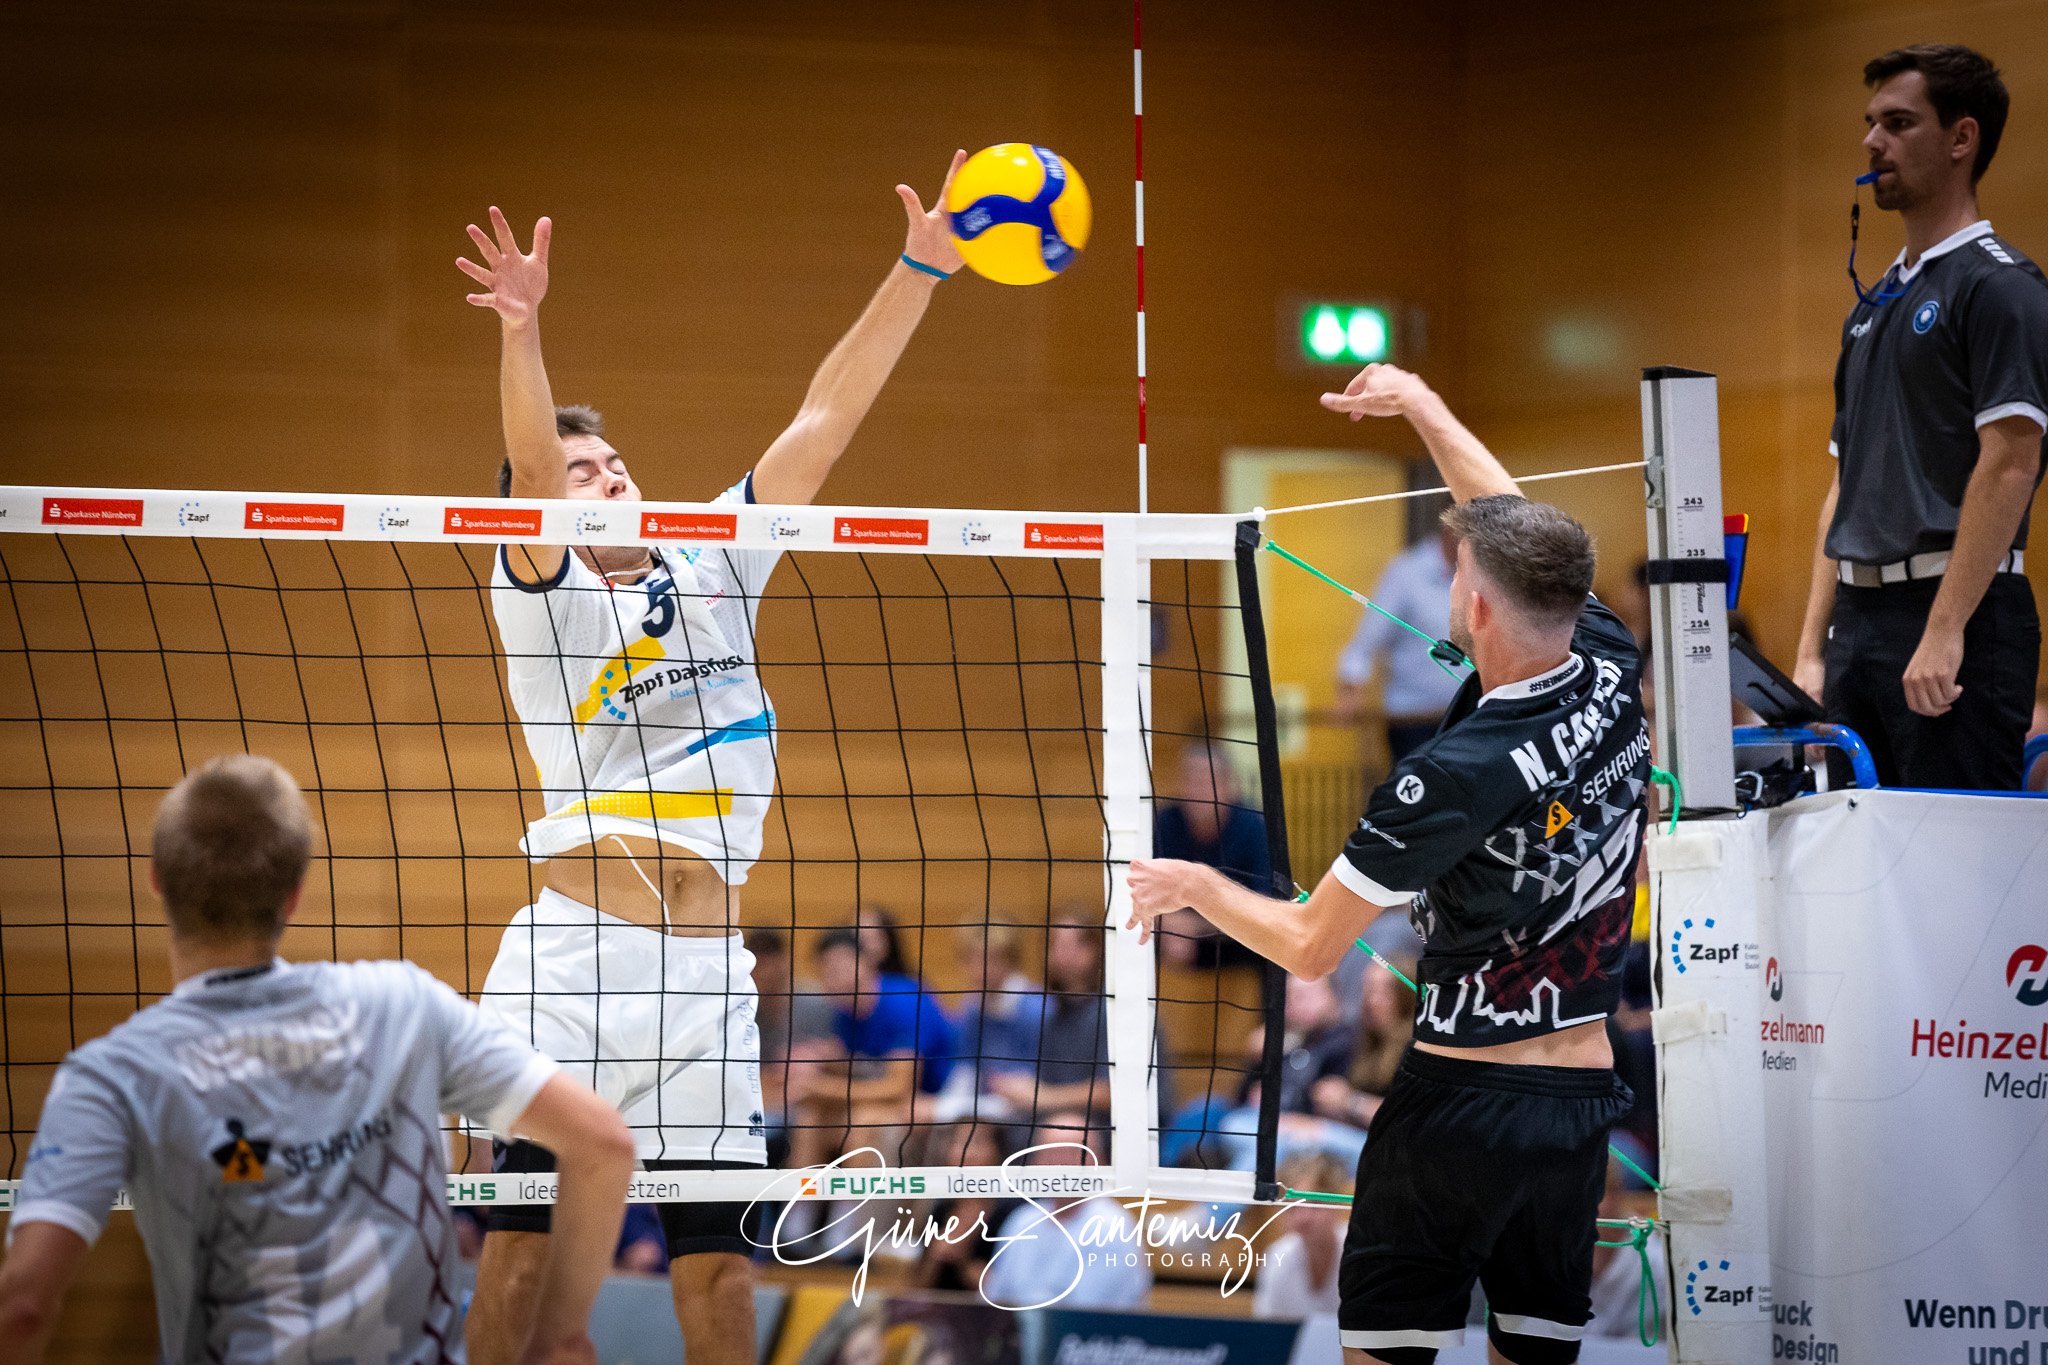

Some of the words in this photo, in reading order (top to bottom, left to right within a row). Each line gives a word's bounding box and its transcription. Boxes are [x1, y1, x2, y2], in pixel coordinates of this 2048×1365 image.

[1684, 497, 1704, 506] 243
[63, 510, 101, 520] Sparkasse
[101, 511, 136, 521] Nürnberg
[187, 514, 210, 523] Zapf
[265, 514, 302, 524] Sparkasse
[303, 516, 337, 526] Nürnberg
[387, 519, 409, 528] Zapf
[464, 519, 500, 529] Sparkasse
[501, 521, 535, 530] Nürnberg
[585, 523, 606, 532] Zapf
[660, 524, 696, 533] Sparkasse
[697, 526, 730, 535] Nürnberg
[779, 528, 800, 537] Zapf
[853, 529, 889, 538] Sparkasse
[890, 530, 922, 540] Nürnberg
[970, 533, 991, 542] Zapf
[1044, 535, 1078, 543] Sparkasse
[1079, 535, 1104, 544] Nürnb
[1687, 549, 1706, 557] 235
[619, 672, 663, 703] Zapf
[1509, 740, 1558, 793] N.
[1582, 726, 1650, 805] SEHRING
[1690, 943, 1739, 964] Zapf
[1761, 1013, 1825, 1044] zelmann
[830, 1176, 926, 1195] FUCHS
[948, 1173, 1001, 1193] Ideen
[1008, 1172, 1105, 1193] umsetzen
[446, 1183, 496, 1201] CHS
[519, 1180, 558, 1199] Idee
[626, 1180, 680, 1198] etzen
[1704, 1286, 1754, 1307] Zapf
[1773, 1300, 1813, 1327] uck
[1904, 1299, 1996, 1329] Wenn
[1772, 1333, 1839, 1365] Design
[1968, 1340, 2030, 1365] und
